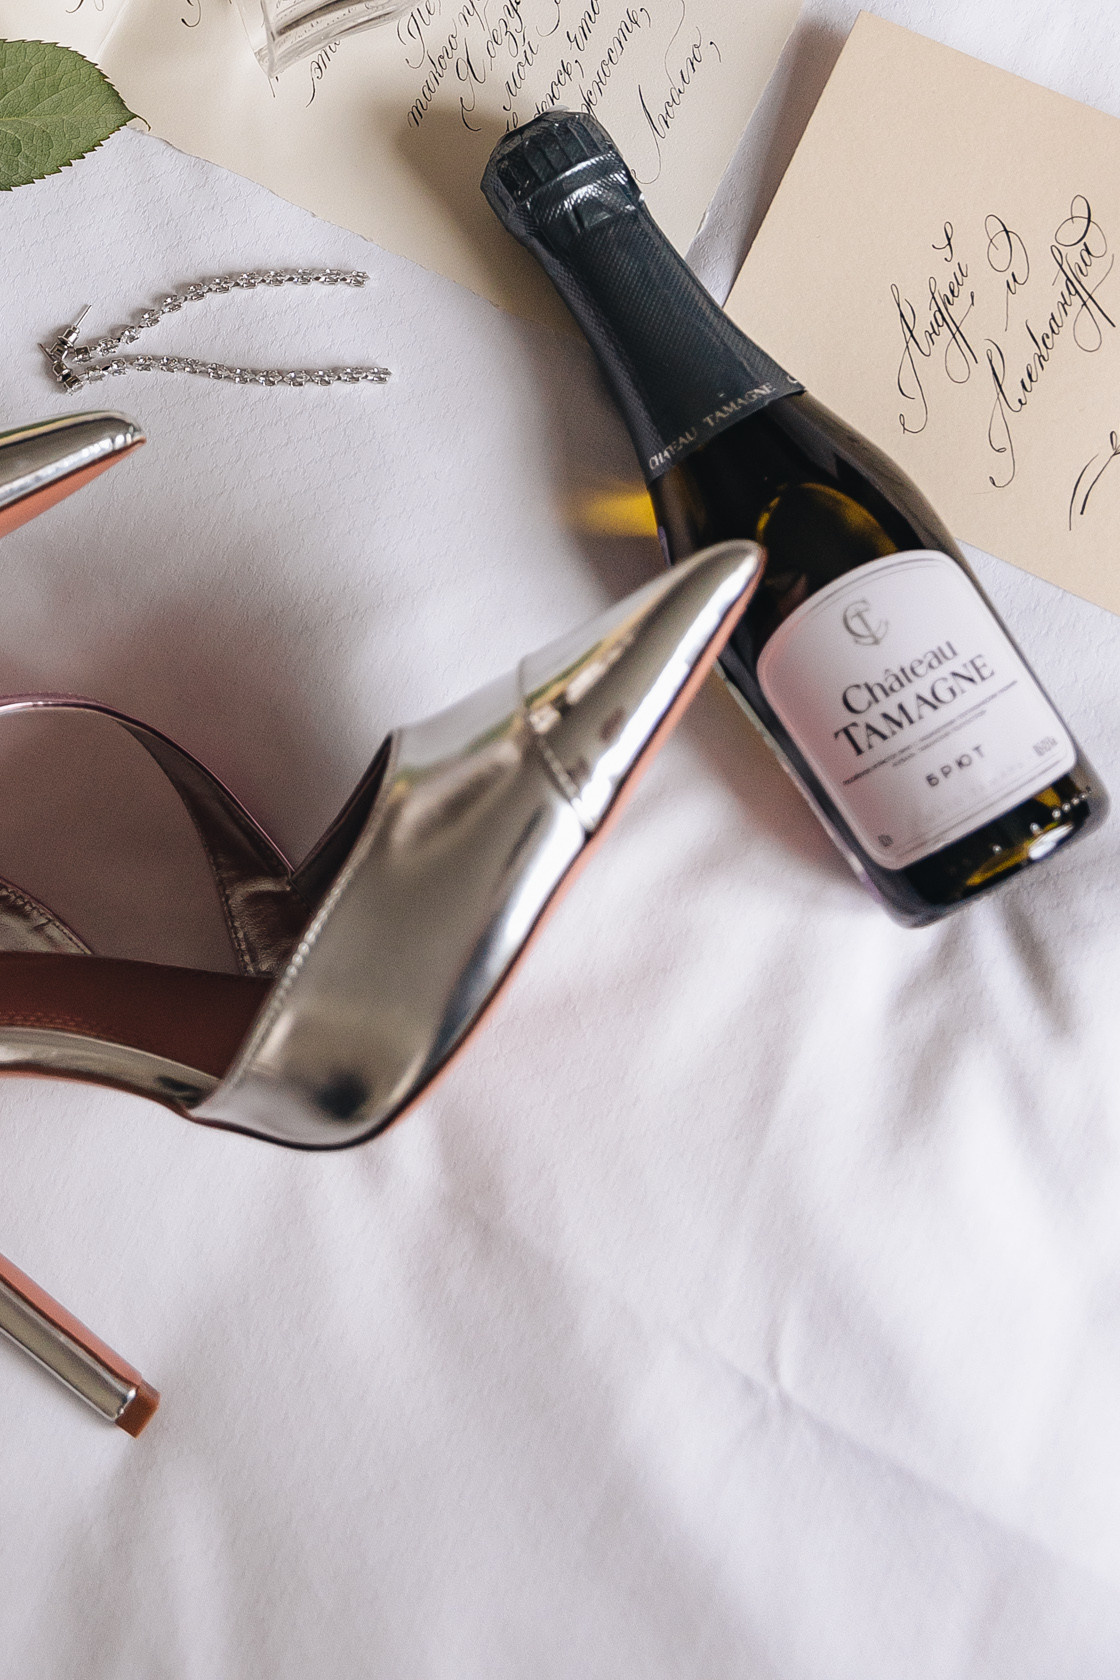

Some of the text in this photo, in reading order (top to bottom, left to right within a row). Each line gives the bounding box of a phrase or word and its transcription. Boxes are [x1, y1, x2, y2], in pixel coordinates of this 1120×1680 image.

[406, 18, 462, 128] такого
[502, 25, 540, 110] мой
[890, 221, 978, 434] Андрей
[984, 194, 1116, 488] Александра
[702, 381, 777, 428] TAMAGNE
[833, 653, 995, 757] TAMAGNE
[840, 639, 959, 715] Château
[925, 744, 987, 788] БРЮТ
